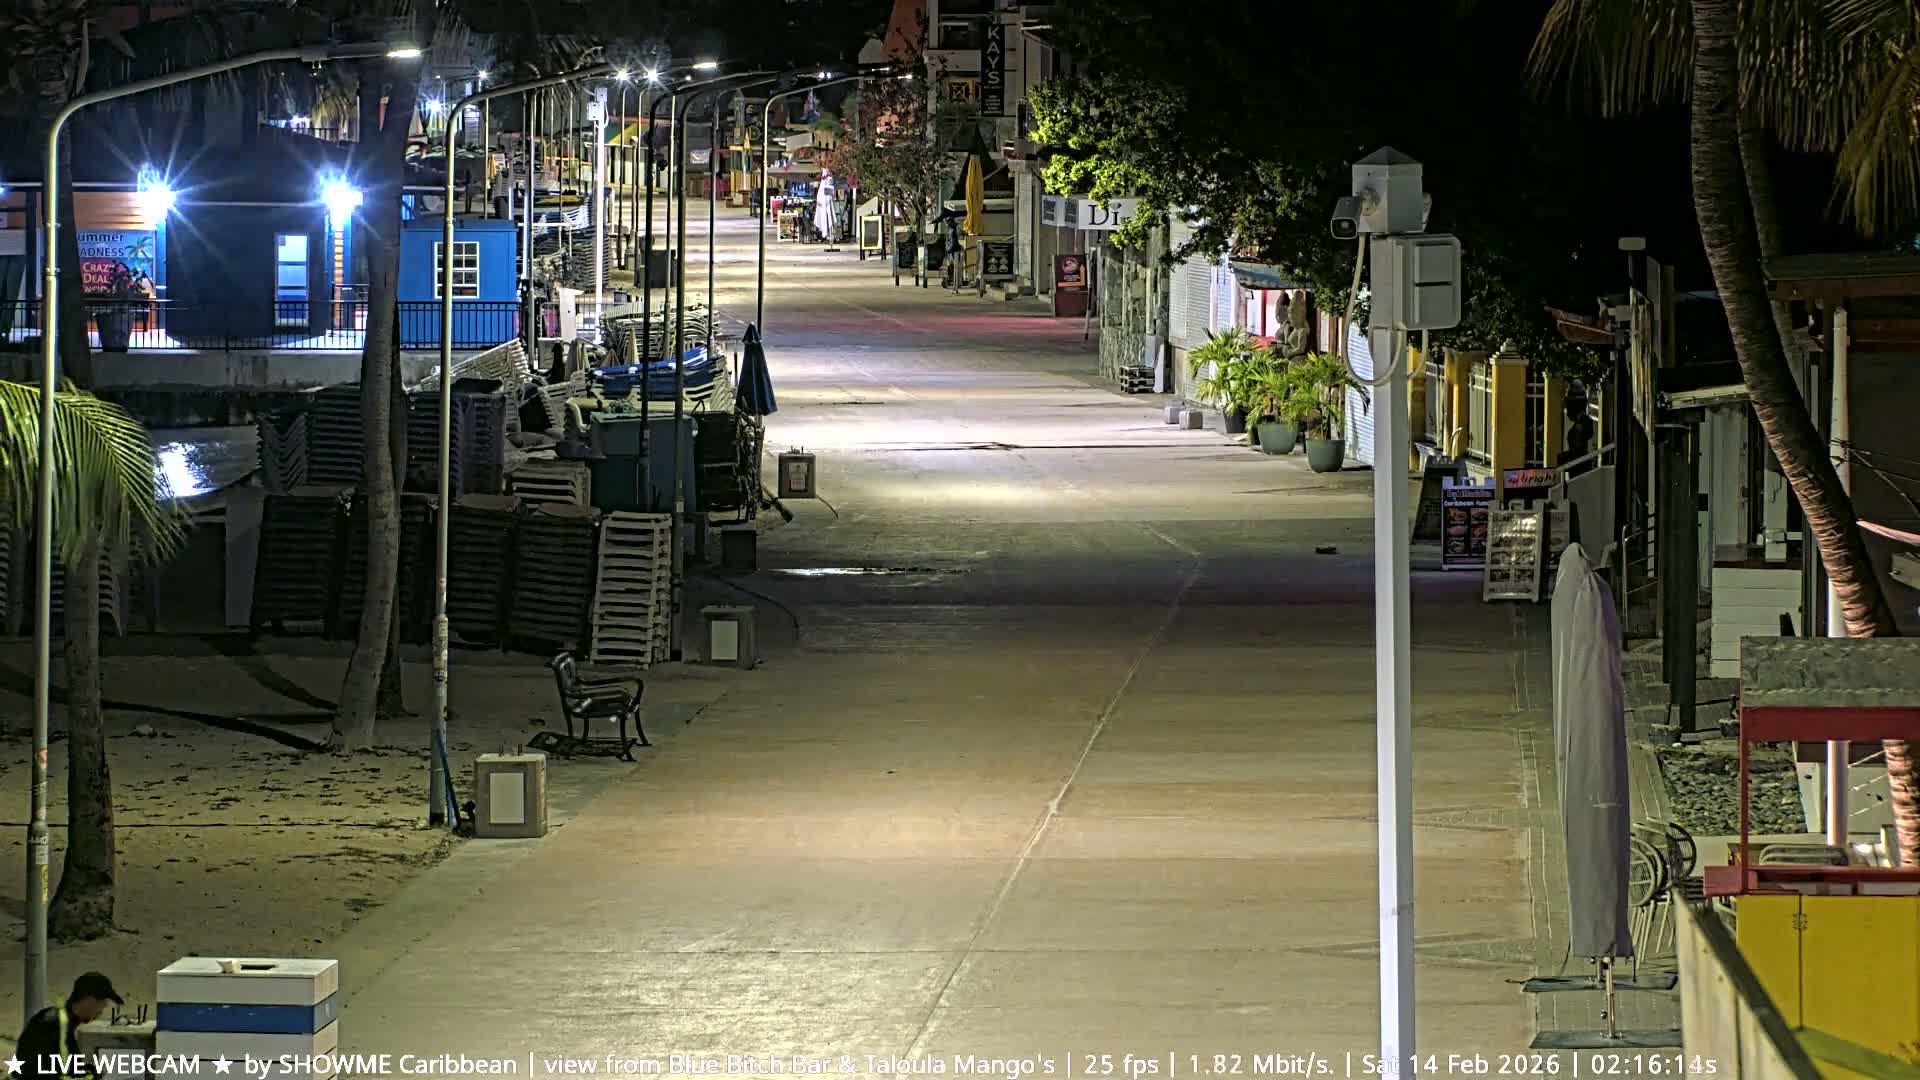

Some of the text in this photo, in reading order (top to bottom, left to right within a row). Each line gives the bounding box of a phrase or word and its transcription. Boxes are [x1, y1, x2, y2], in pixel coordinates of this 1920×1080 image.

[986, 25, 1001, 85] KAYS
[79, 233, 123, 242] ummer
[79, 247, 125, 257] ADNESS
[82, 273, 113, 284] DEAL
